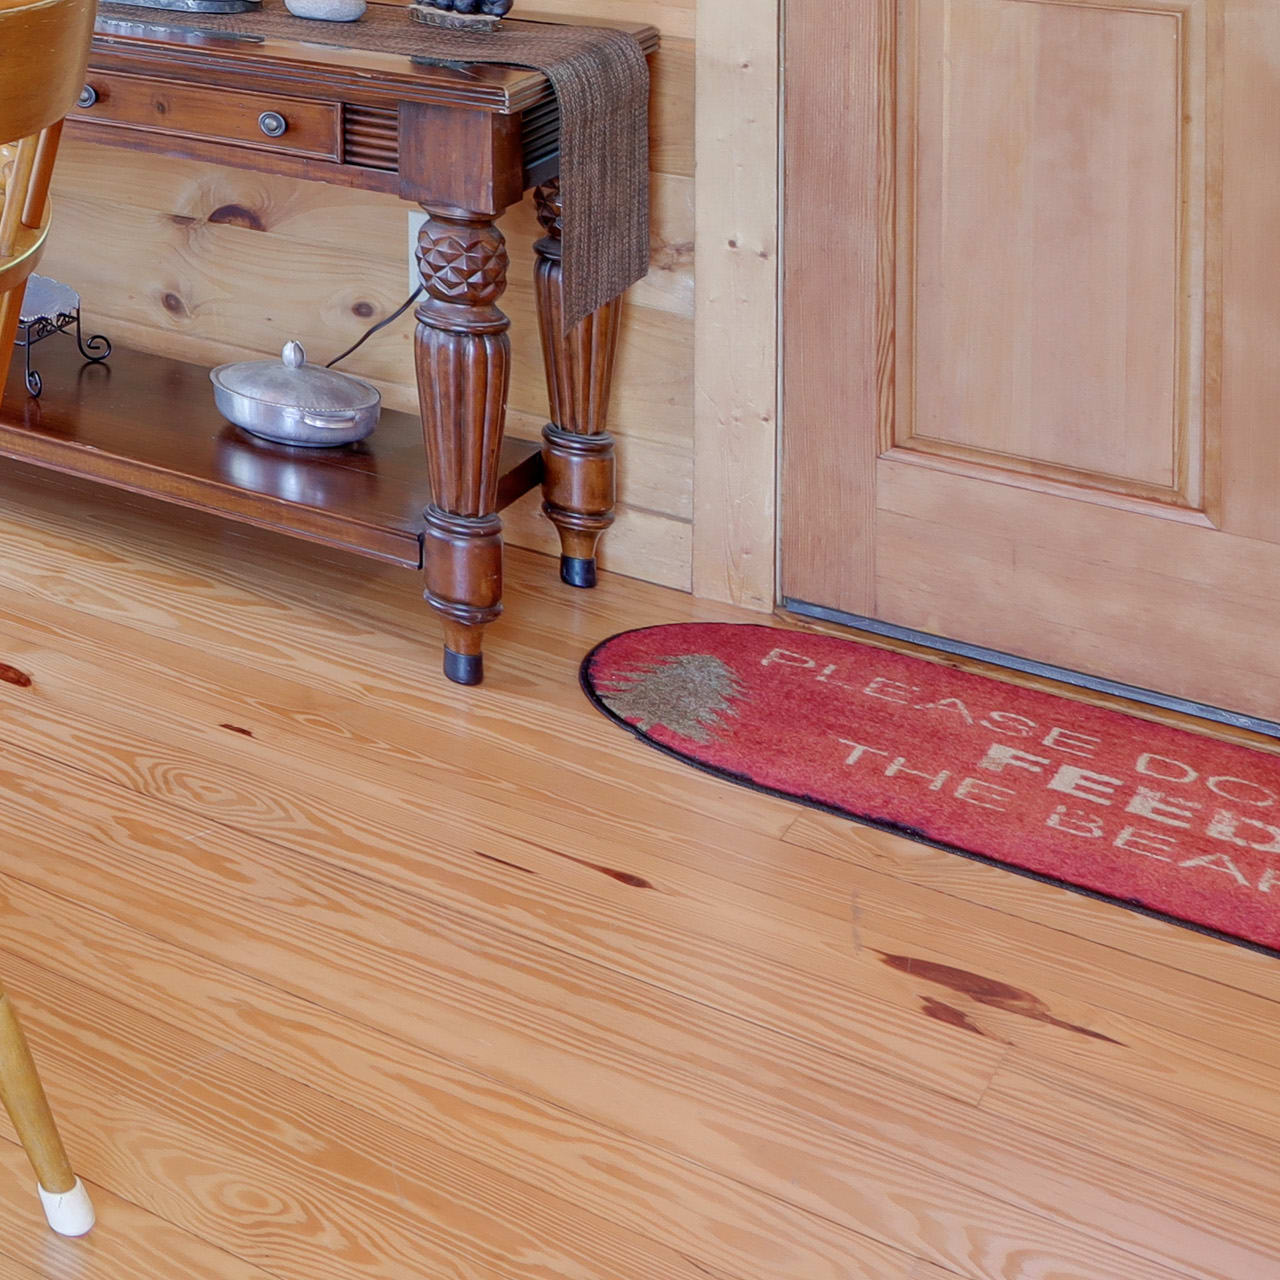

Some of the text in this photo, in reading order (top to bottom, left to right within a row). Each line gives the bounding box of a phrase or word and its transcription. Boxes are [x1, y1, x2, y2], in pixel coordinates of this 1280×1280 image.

[761, 648, 1102, 758] PLEASE
[835, 735, 1016, 812] THE
[979, 743, 1280, 853] FEED
